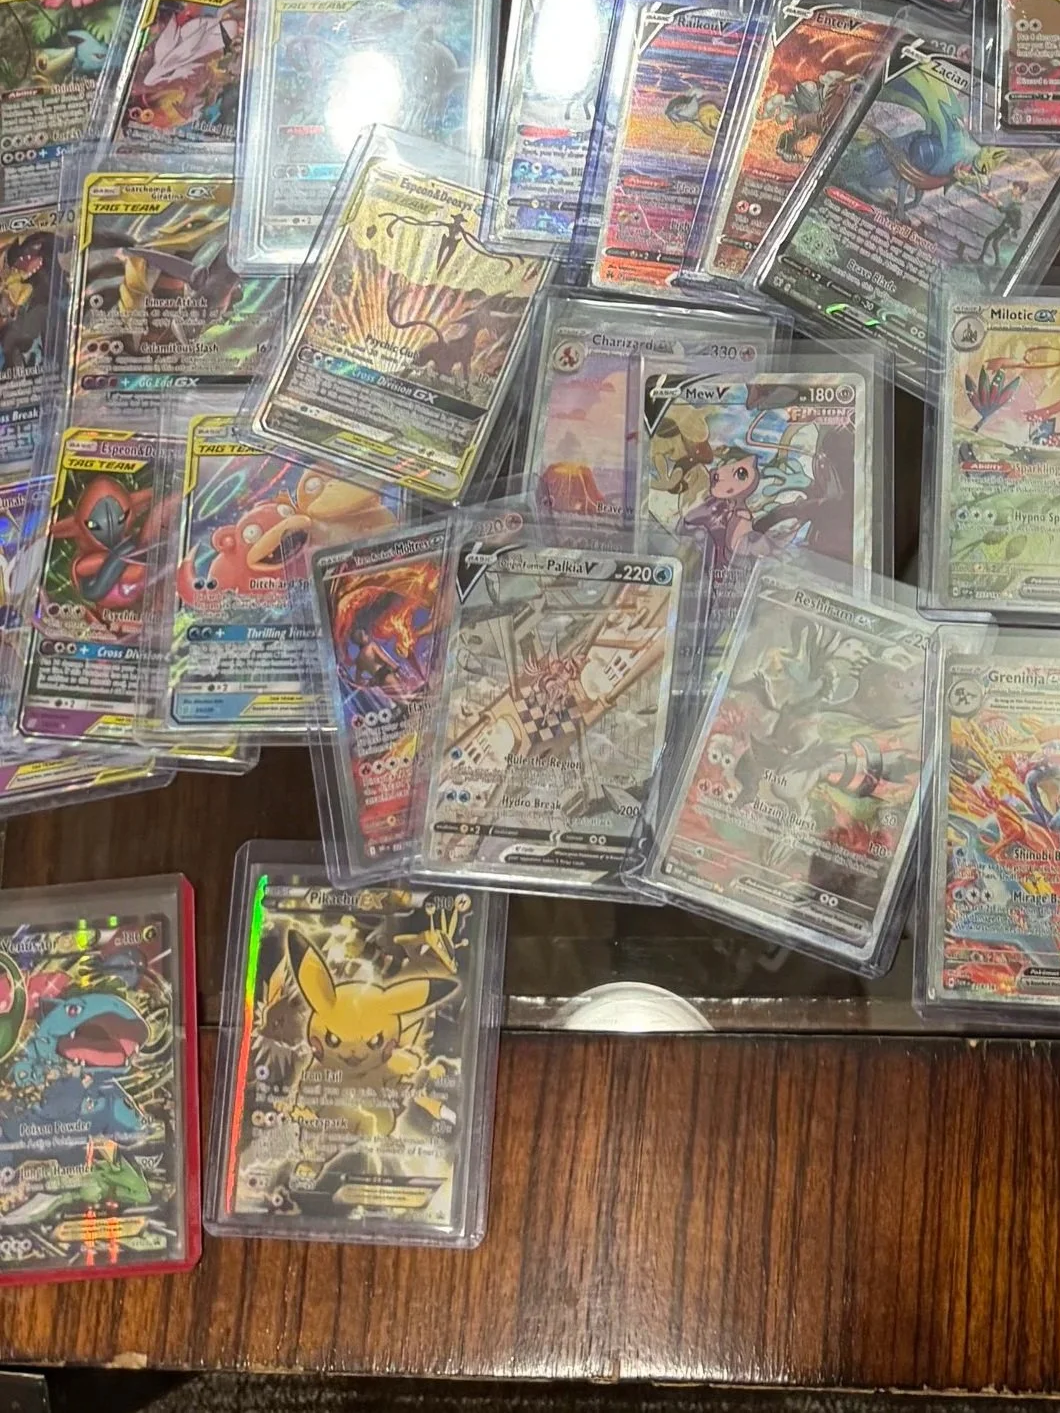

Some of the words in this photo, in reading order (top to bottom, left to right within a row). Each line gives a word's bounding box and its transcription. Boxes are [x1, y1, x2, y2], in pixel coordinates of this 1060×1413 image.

[281, 0, 307, 11] TAG
[311, 0, 353, 12] TEAM
[930, 61, 970, 89] Zacian
[399, 177, 474, 212] Espeon&Deoxys
[92, 202, 117, 213] TAG
[121, 202, 161, 213] TEAM
[175, 297, 208, 309] Attack
[990, 308, 1034, 322] Milotic
[139, 344, 193, 356] Calamitous
[194, 343, 219, 356] Slash
[365, 333, 398, 355] Psychic
[591, 334, 654, 354] Charizard
[710, 345, 738, 361] 330
[351, 367, 376, 384] Cross
[376, 374, 413, 396] Division
[412, 384, 440, 405] GX
[685, 386, 715, 400] Mew
[808, 387, 835, 403] 180
[13, 408, 40, 421] Break
[199, 443, 226, 454] TAG
[66, 458, 93, 468] TAG
[98, 459, 137, 471] TEAM
[970, 462, 1003, 472] Ability
[1014, 511, 1046, 526] Hypno
[546, 559, 583, 575] Palkia
[622, 564, 652, 582] 220
[793, 591, 854, 621] Reshiram
[97, 646, 125, 659] Cross
[988, 669, 1046, 687] Greninja
[506, 753, 525, 769] Rule
[549, 755, 584, 773] Region
[763, 768, 788, 787] Slash
[500, 795, 528, 812] Hydro
[529, 796, 562, 813] Break
[619, 804, 641, 818] 200
[787, 812, 817, 832] Burst
[1013, 847, 1052, 863] Shinobi
[310, 890, 360, 908] Pikachu
[1012, 890, 1049, 907] Mirage
